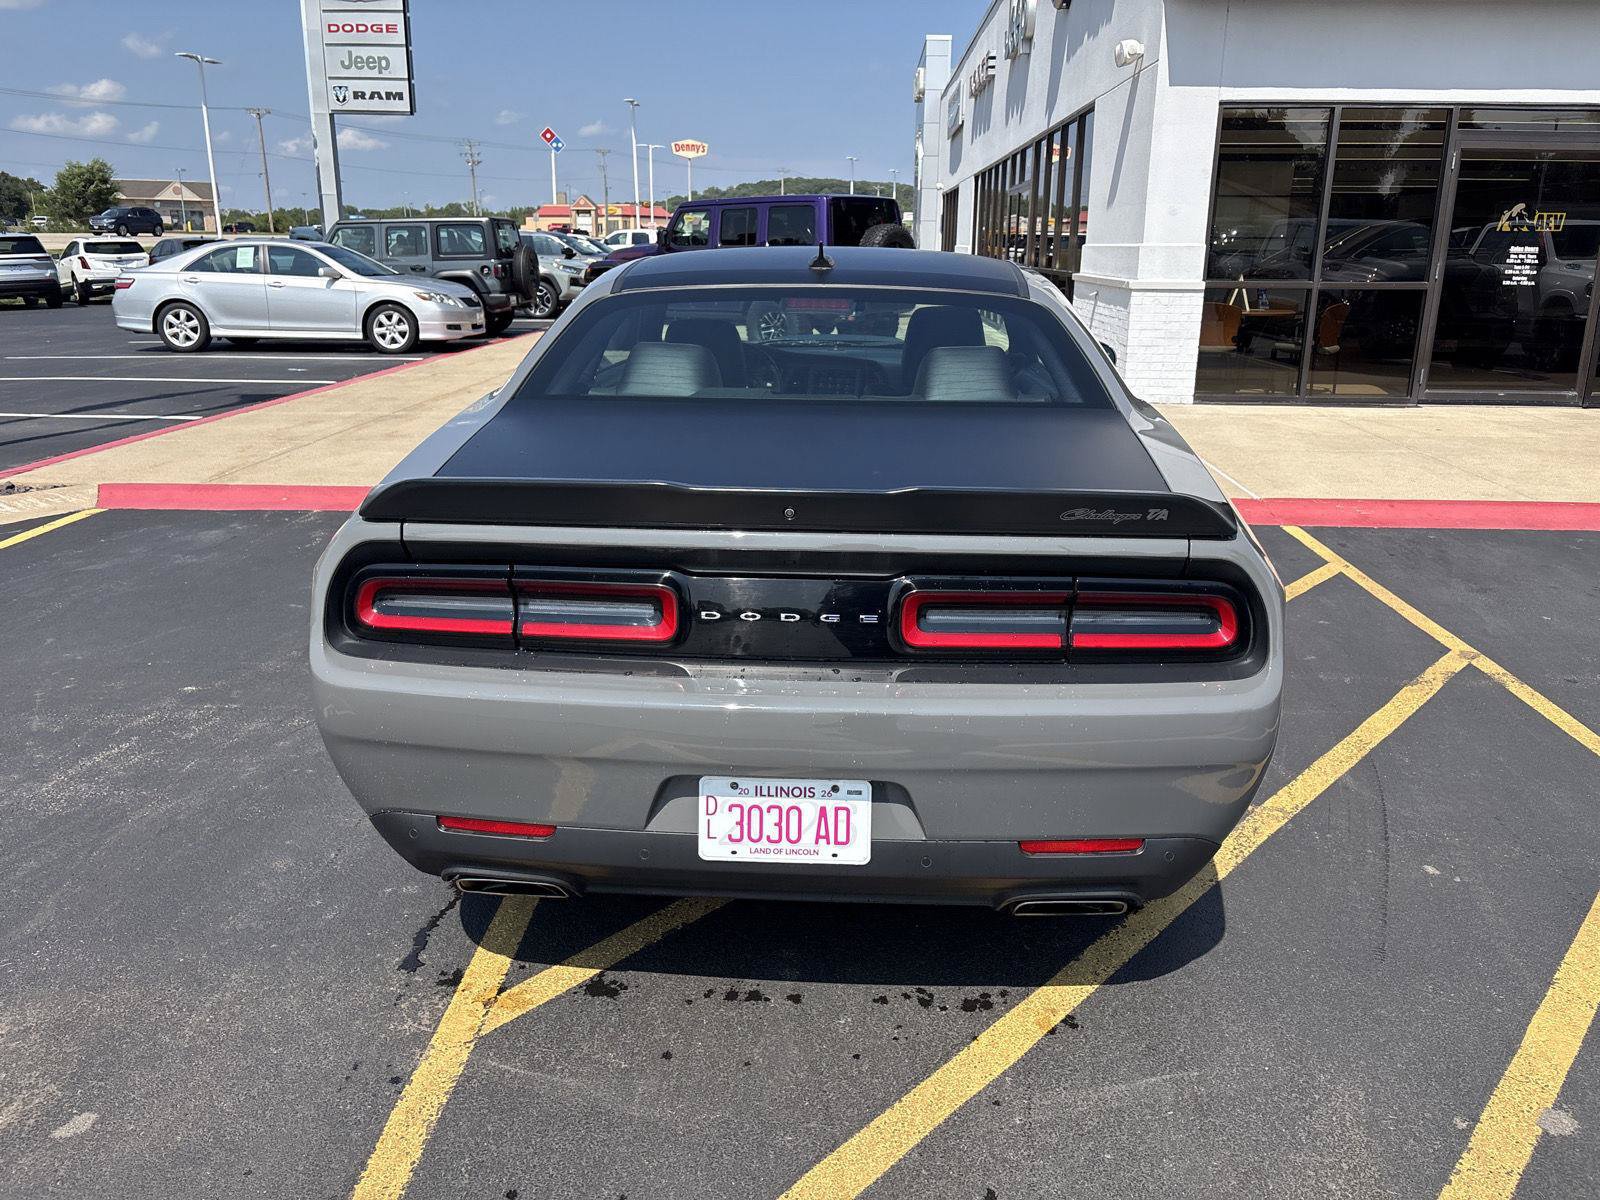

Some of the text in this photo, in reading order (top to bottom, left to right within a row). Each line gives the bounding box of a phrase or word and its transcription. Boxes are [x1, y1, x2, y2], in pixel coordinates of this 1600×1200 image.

[327, 23, 398, 33] DODGE
[340, 50, 391, 74] Jeep
[352, 90, 404, 101] RAM
[674, 143, 706, 154] Denny's
[1060, 508, 1143, 525] Challenger
[701, 611, 879, 623] DODGE
[738, 785, 833, 798] 20 ILLINOIS 26
[728, 803, 851, 846] 3030 AD
[749, 847, 771, 855] LAND
[785, 848, 819, 856] LINCOLN
